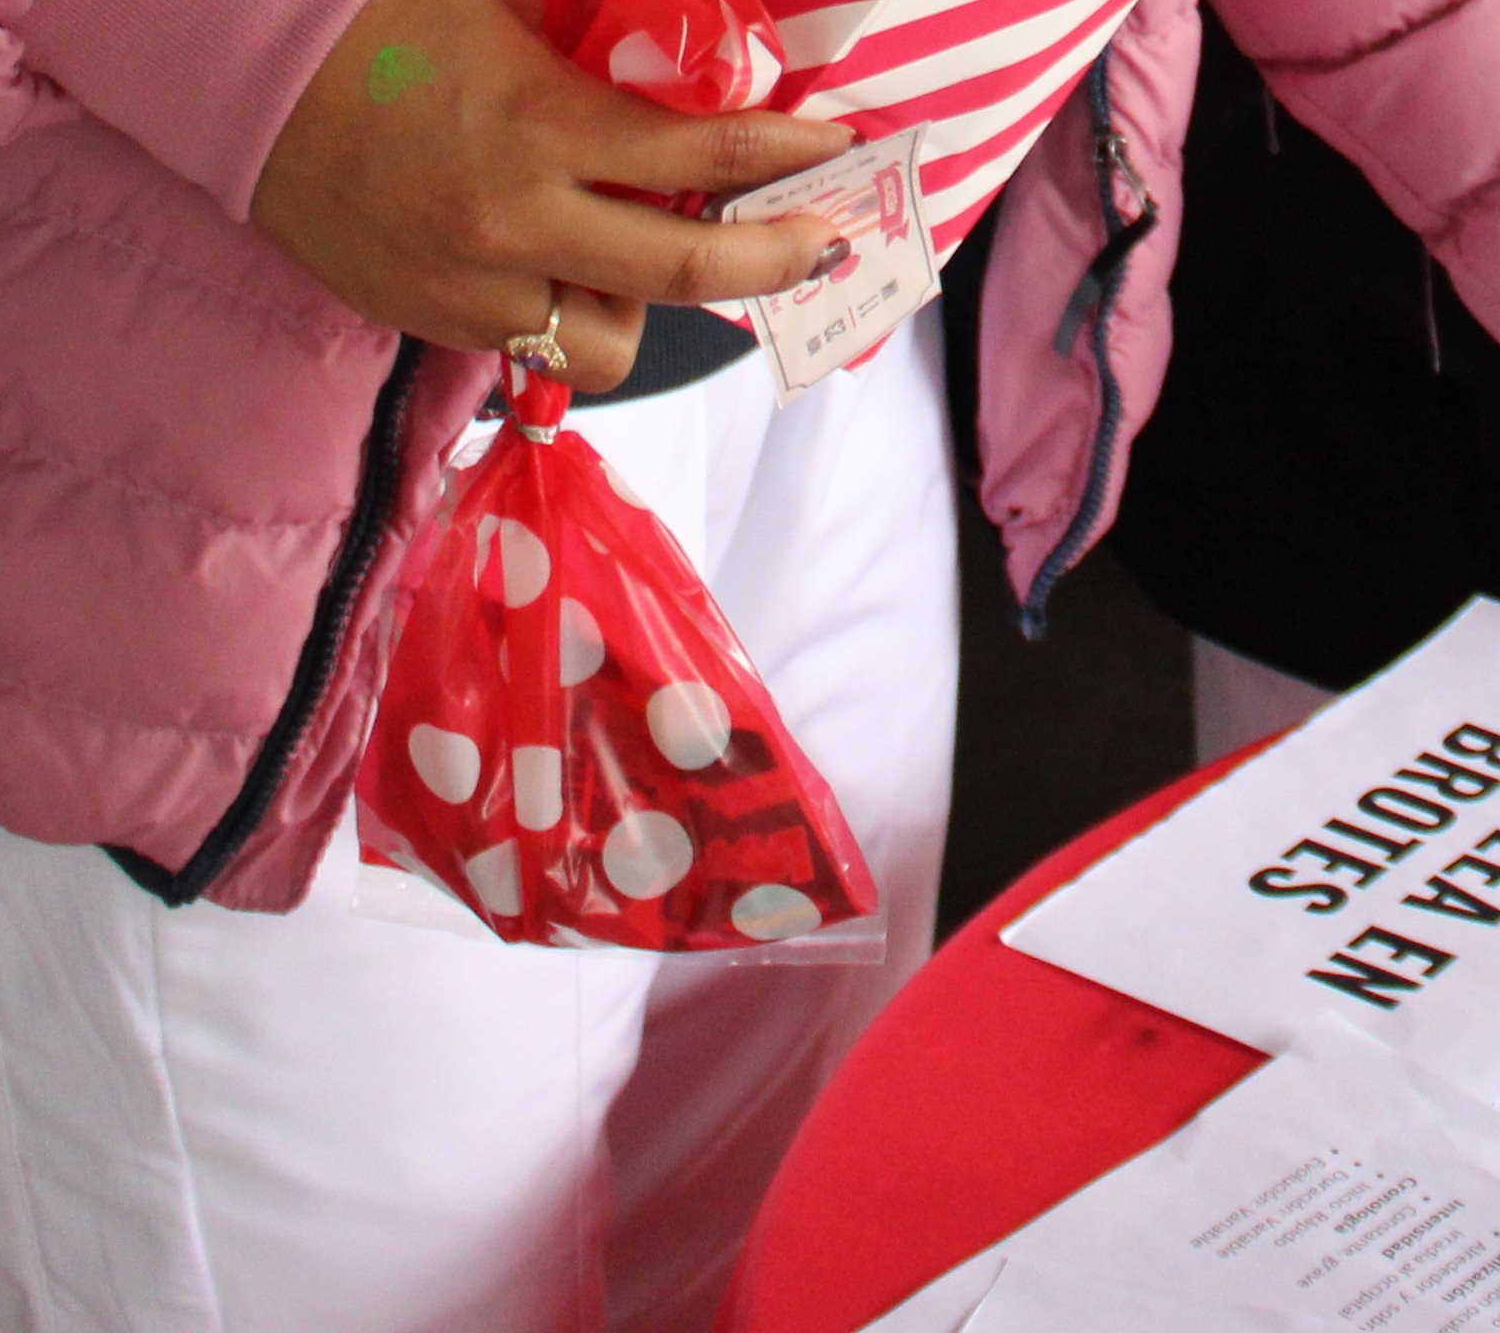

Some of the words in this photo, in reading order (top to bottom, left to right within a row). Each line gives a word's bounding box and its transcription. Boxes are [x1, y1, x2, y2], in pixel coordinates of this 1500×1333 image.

[1305, 924, 1459, 1011] EN
[1190, 1206, 1255, 1247] Variable
[1333, 1177, 1418, 1233] Cronología
[1216, 1217, 1281, 1258] Variable
[1274, 1211, 1329, 1247] Rápido
[1336, 1204, 1417, 1256] Constante,
[1381, 1200, 1465, 1260] Intensidad
[1413, 1229, 1462, 1264] irradia
[1296, 1255, 1340, 1288] grave
[1415, 1241, 1486, 1294] Alrededor
[1337, 1274, 1399, 1321] occipital
[1396, 1291, 1414, 1304] y
